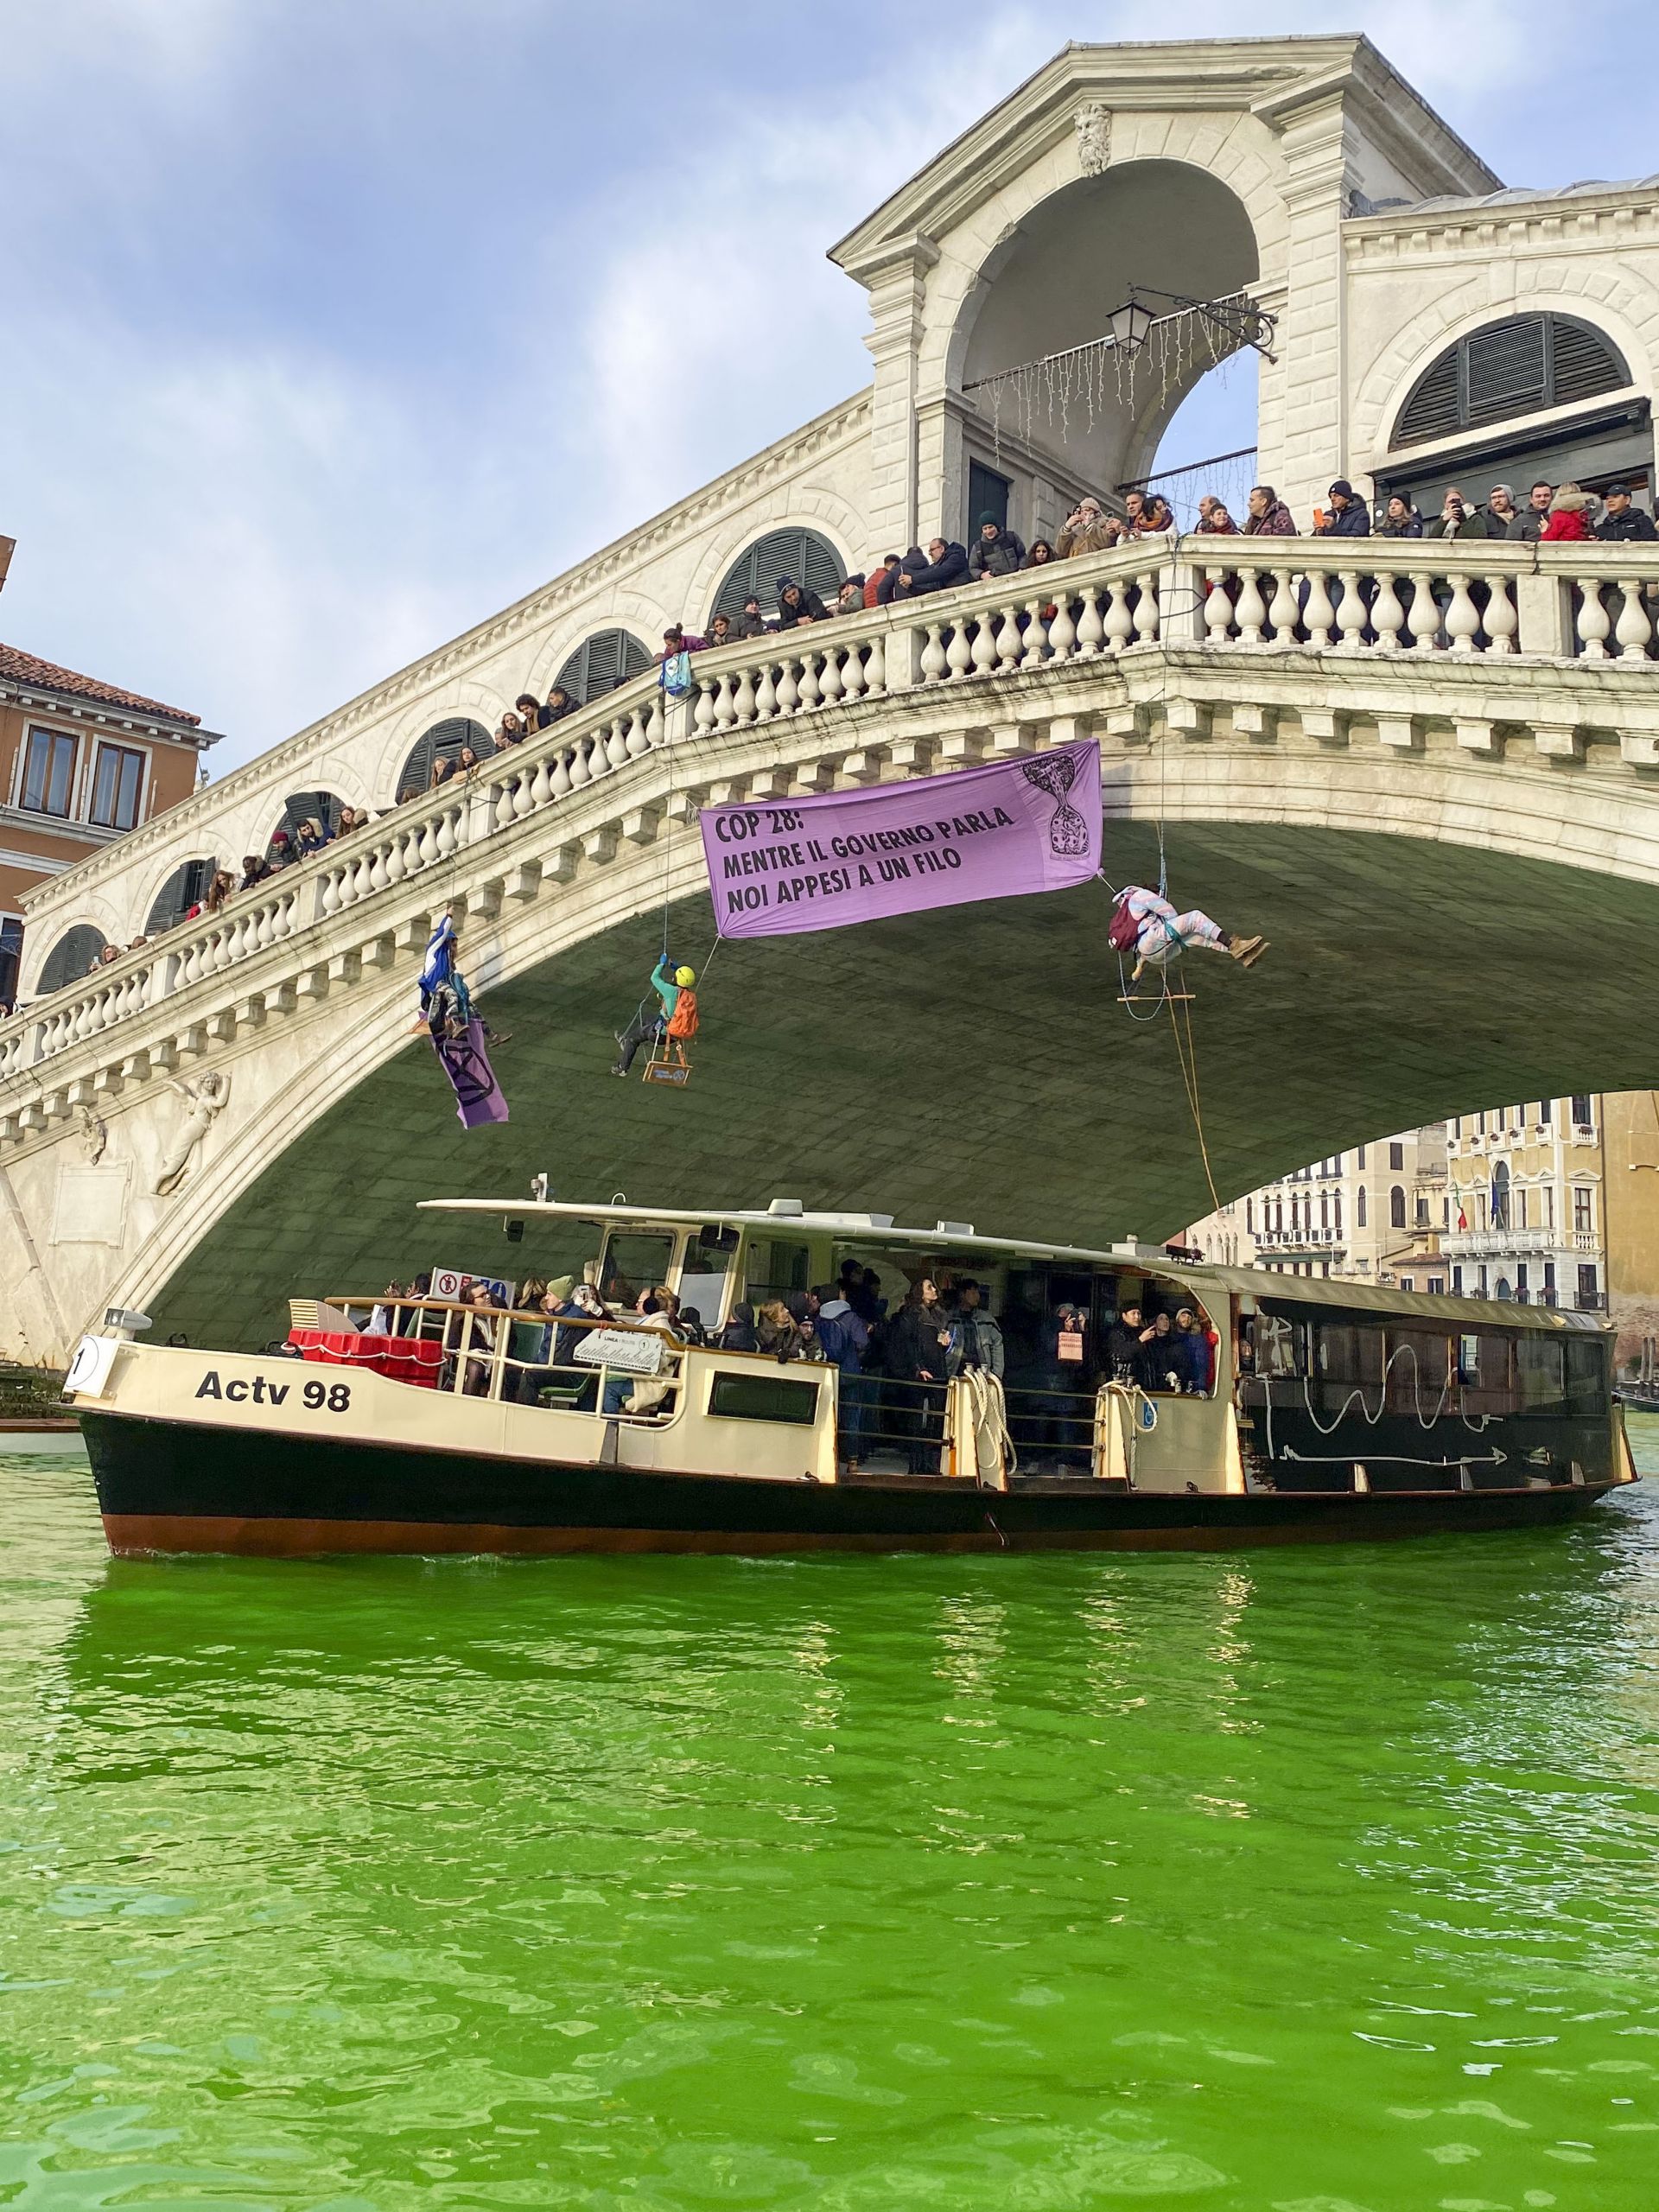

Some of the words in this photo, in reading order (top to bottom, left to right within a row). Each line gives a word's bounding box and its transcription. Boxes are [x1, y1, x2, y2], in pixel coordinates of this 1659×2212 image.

[715, 811, 760, 842] COP
[766, 809, 804, 834] 28:
[723, 842, 805, 879] MENTRE
[806, 840, 829, 862] IL
[831, 824, 935, 858] GOVERNO
[935, 807, 1014, 839] PARLA
[728, 884, 769, 913] NOI
[778, 868, 851, 904] APPESI
[858, 864, 874, 887] A
[877, 857, 911, 882] UN
[912, 848, 962, 874] FILO
[73, 1348, 86, 1375] 1
[194, 1370, 290, 1406] Actv
[302, 1380, 352, 1413] 98
